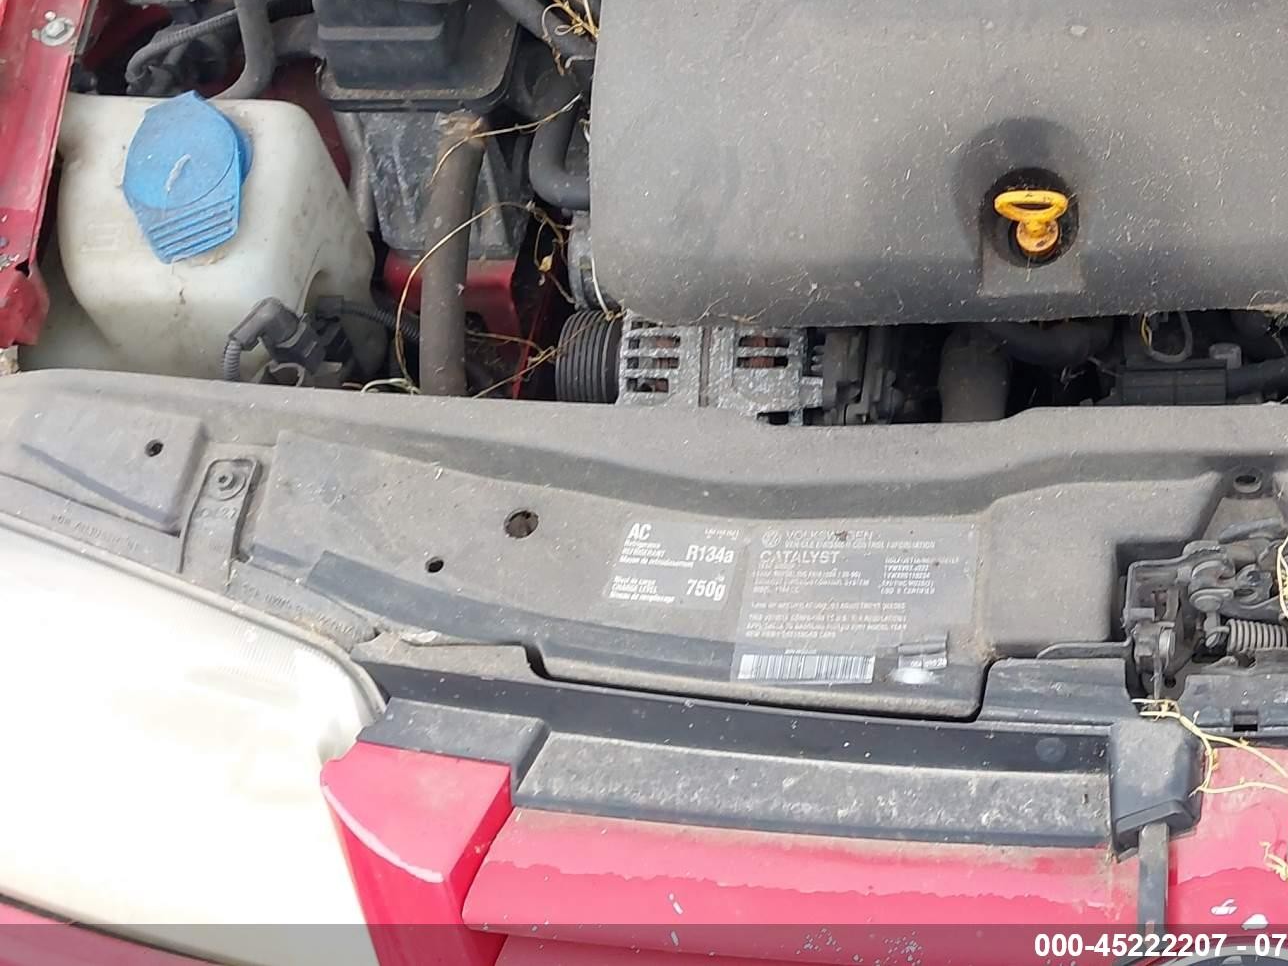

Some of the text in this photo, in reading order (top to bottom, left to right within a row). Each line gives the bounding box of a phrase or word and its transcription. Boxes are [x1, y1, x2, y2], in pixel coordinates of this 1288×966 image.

[626, 522, 652, 540] AC
[686, 543, 735, 564] R134a
[760, 549, 840, 564] CATALYST
[686, 578, 727, 601] 750g
